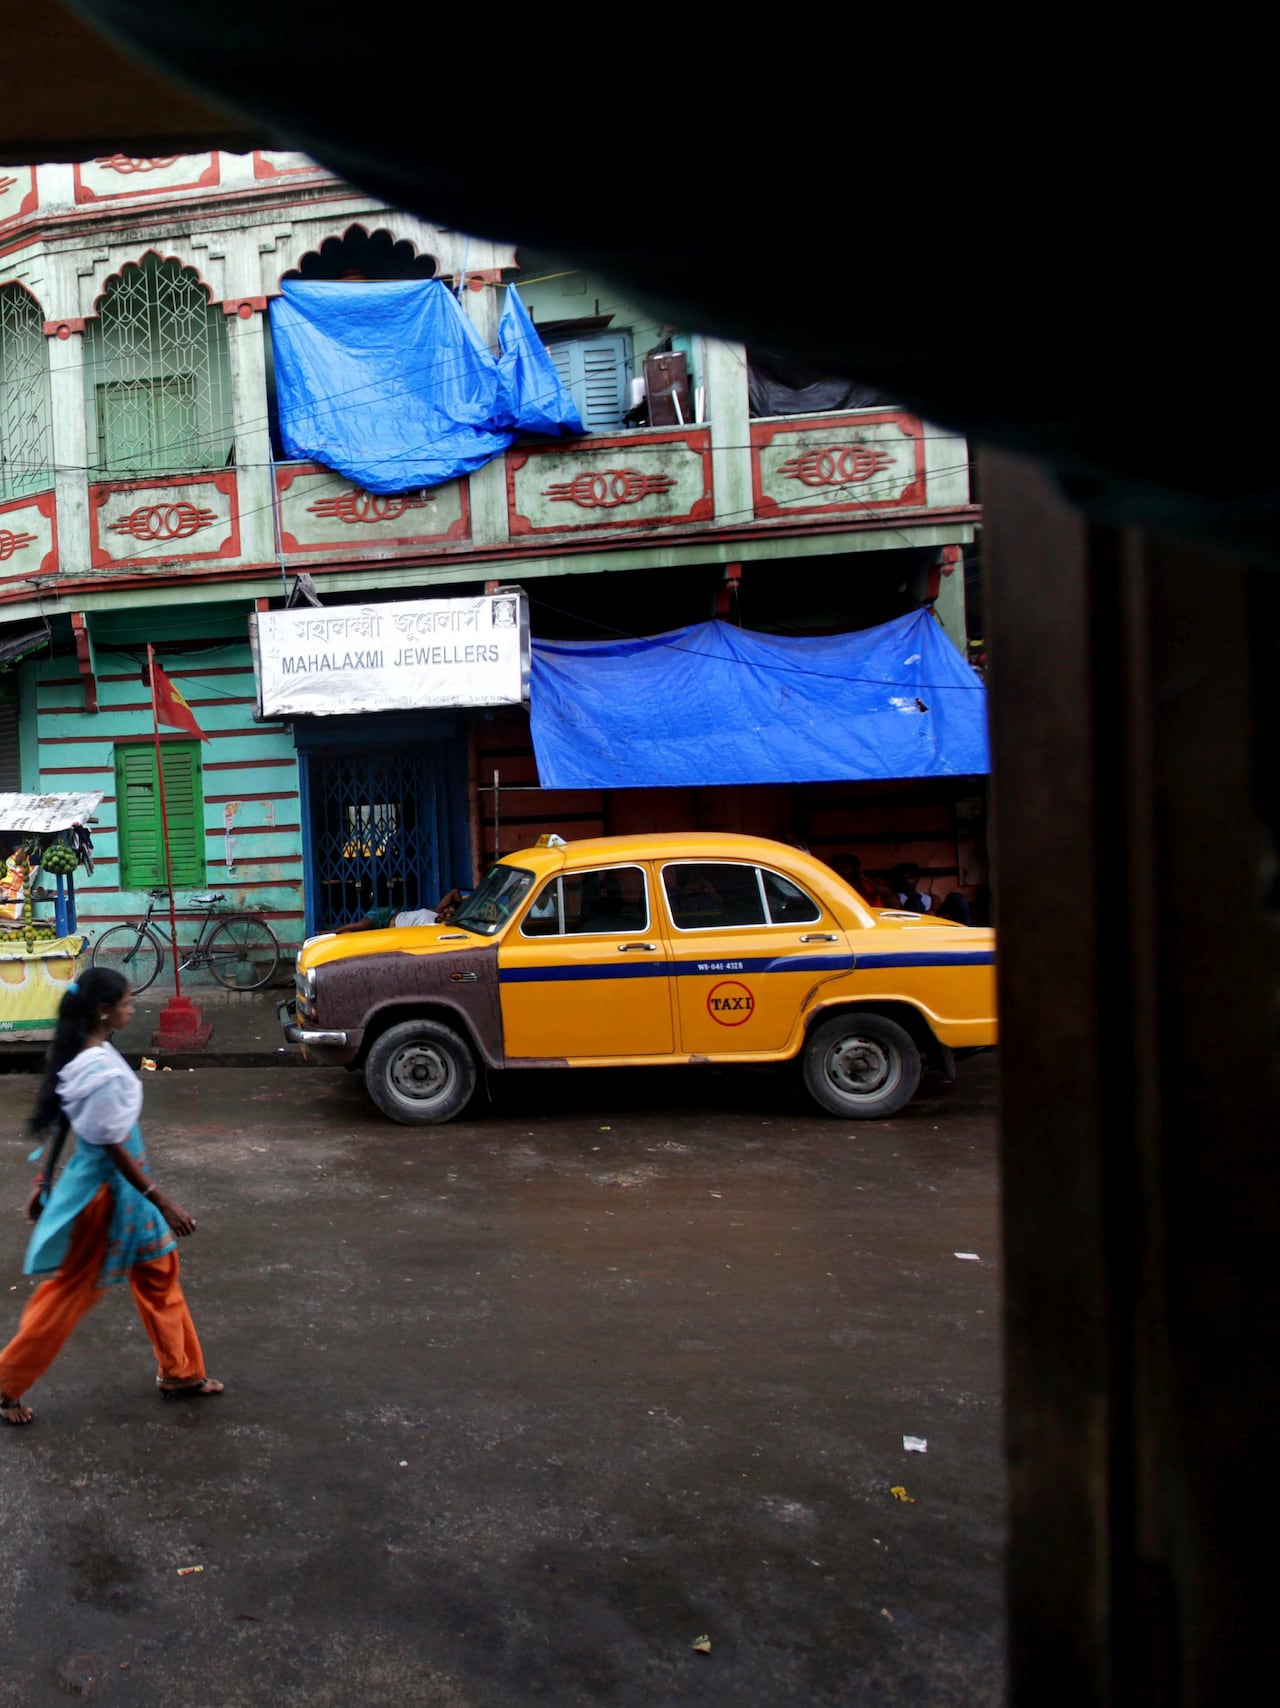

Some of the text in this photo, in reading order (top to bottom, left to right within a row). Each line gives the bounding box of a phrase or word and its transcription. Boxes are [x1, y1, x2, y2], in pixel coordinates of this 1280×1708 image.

[281, 644, 500, 675] MAHALAXMI JEWELLERS
[711, 997, 753, 1011] TAXI
